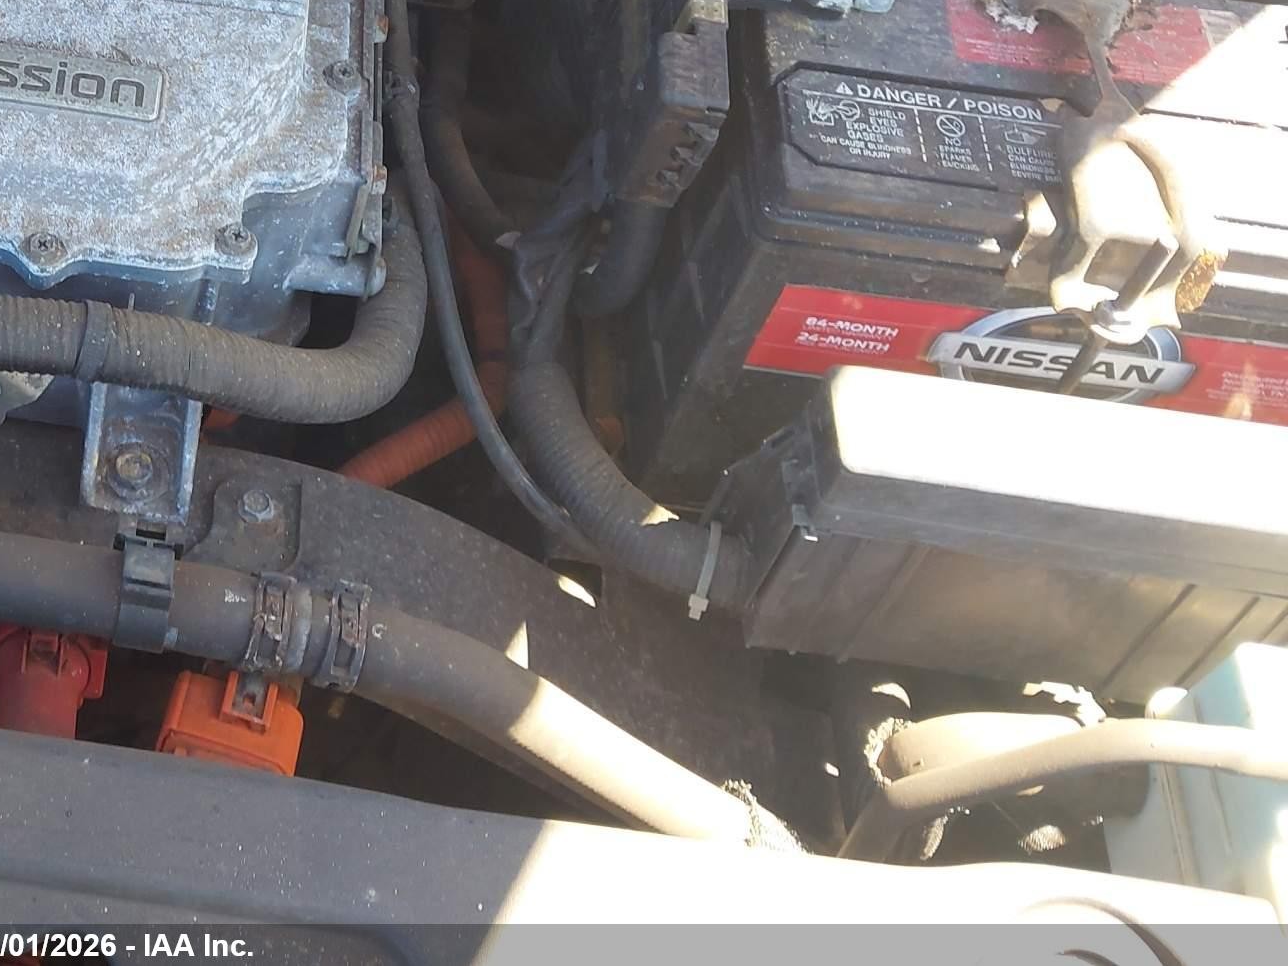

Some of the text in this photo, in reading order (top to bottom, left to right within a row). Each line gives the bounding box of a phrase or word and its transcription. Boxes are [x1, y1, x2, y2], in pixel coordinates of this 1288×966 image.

[856, 83, 942, 109] DANGER
[963, 98, 1043, 122] POISON
[867, 107, 906, 121] SHIELD
[846, 121, 905, 138] EXPLOSIVE
[870, 116, 898, 129] EYES
[820, 134, 838, 145] CAN
[839, 137, 866, 148] CAUSE
[847, 130, 885, 144] GASES
[944, 136, 962, 147] NO
[804, 315, 900, 338] 84-MONTH
[796, 330, 891, 353] 24-MONTH
[954, 341, 1166, 385] NISSAN
